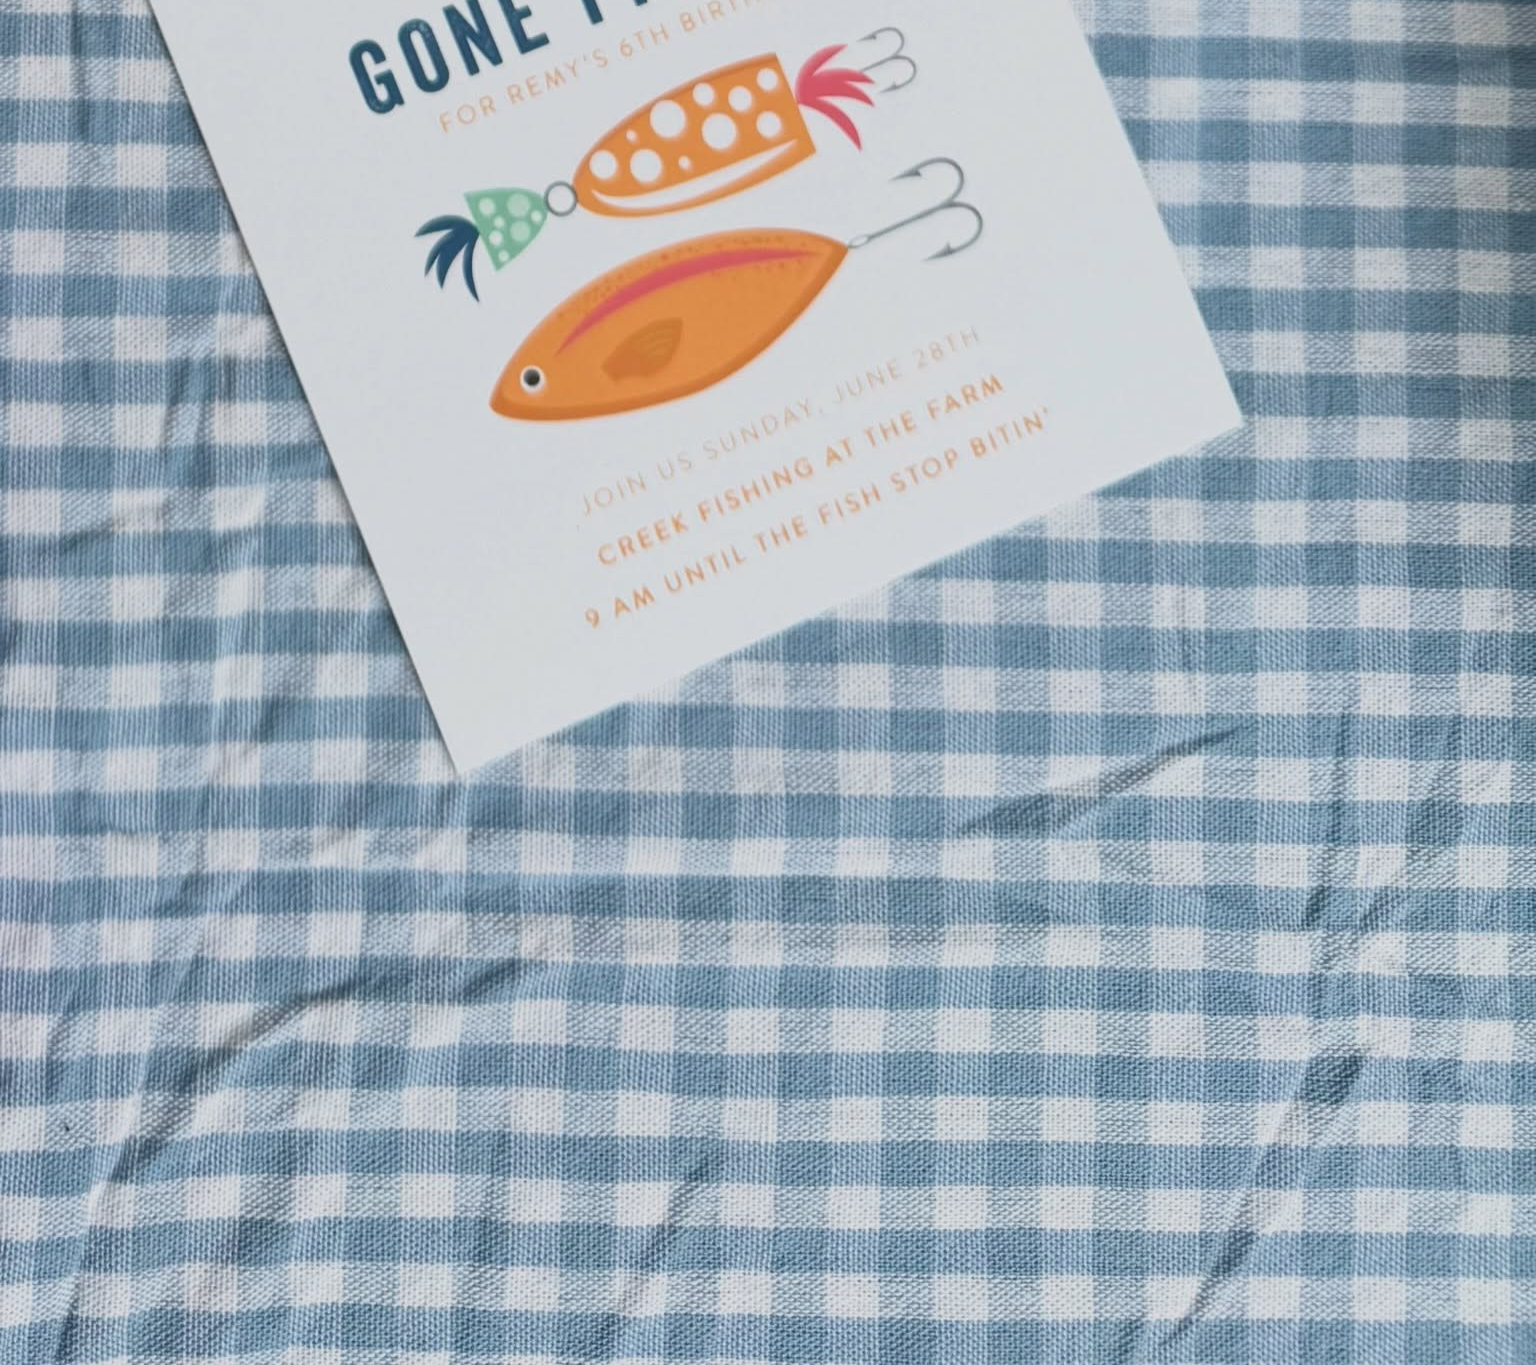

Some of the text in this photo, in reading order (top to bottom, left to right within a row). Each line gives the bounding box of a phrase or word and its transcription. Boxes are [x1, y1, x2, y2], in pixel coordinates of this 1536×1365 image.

[439, 96, 497, 133] FOR
[506, 48, 609, 106] REMY'S
[619, 23, 670, 58] 6TH
[581, 326, 980, 516] JOIN US SUNDAY, JUNE 28TH
[597, 374, 1005, 566] CREEK FISHING AT THE FARM
[584, 406, 1049, 629] 9 AM UNTIL THE FISH STOP BITIN'
